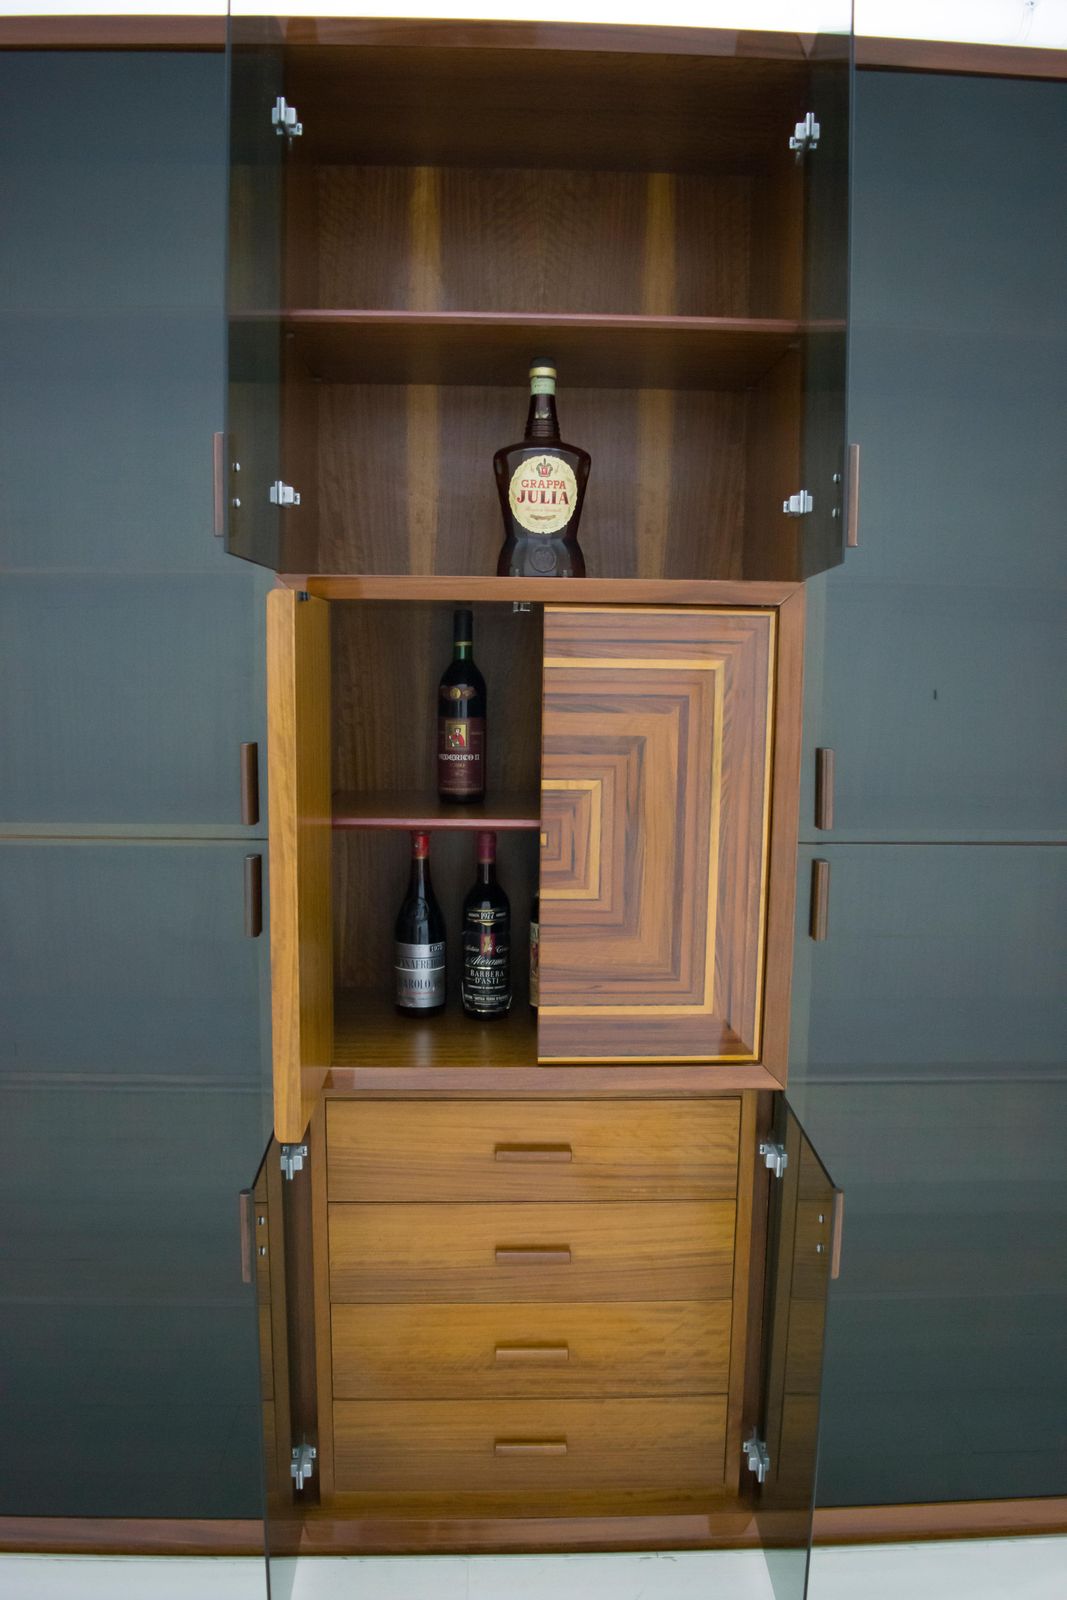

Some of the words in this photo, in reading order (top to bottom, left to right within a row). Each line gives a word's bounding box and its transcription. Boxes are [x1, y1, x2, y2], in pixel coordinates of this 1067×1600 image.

[521, 479, 566, 489] GRAPPA
[516, 489, 569, 505] JULIA
[470, 969, 504, 978] BARBERA
[475, 977, 499, 985] D'ASTI
